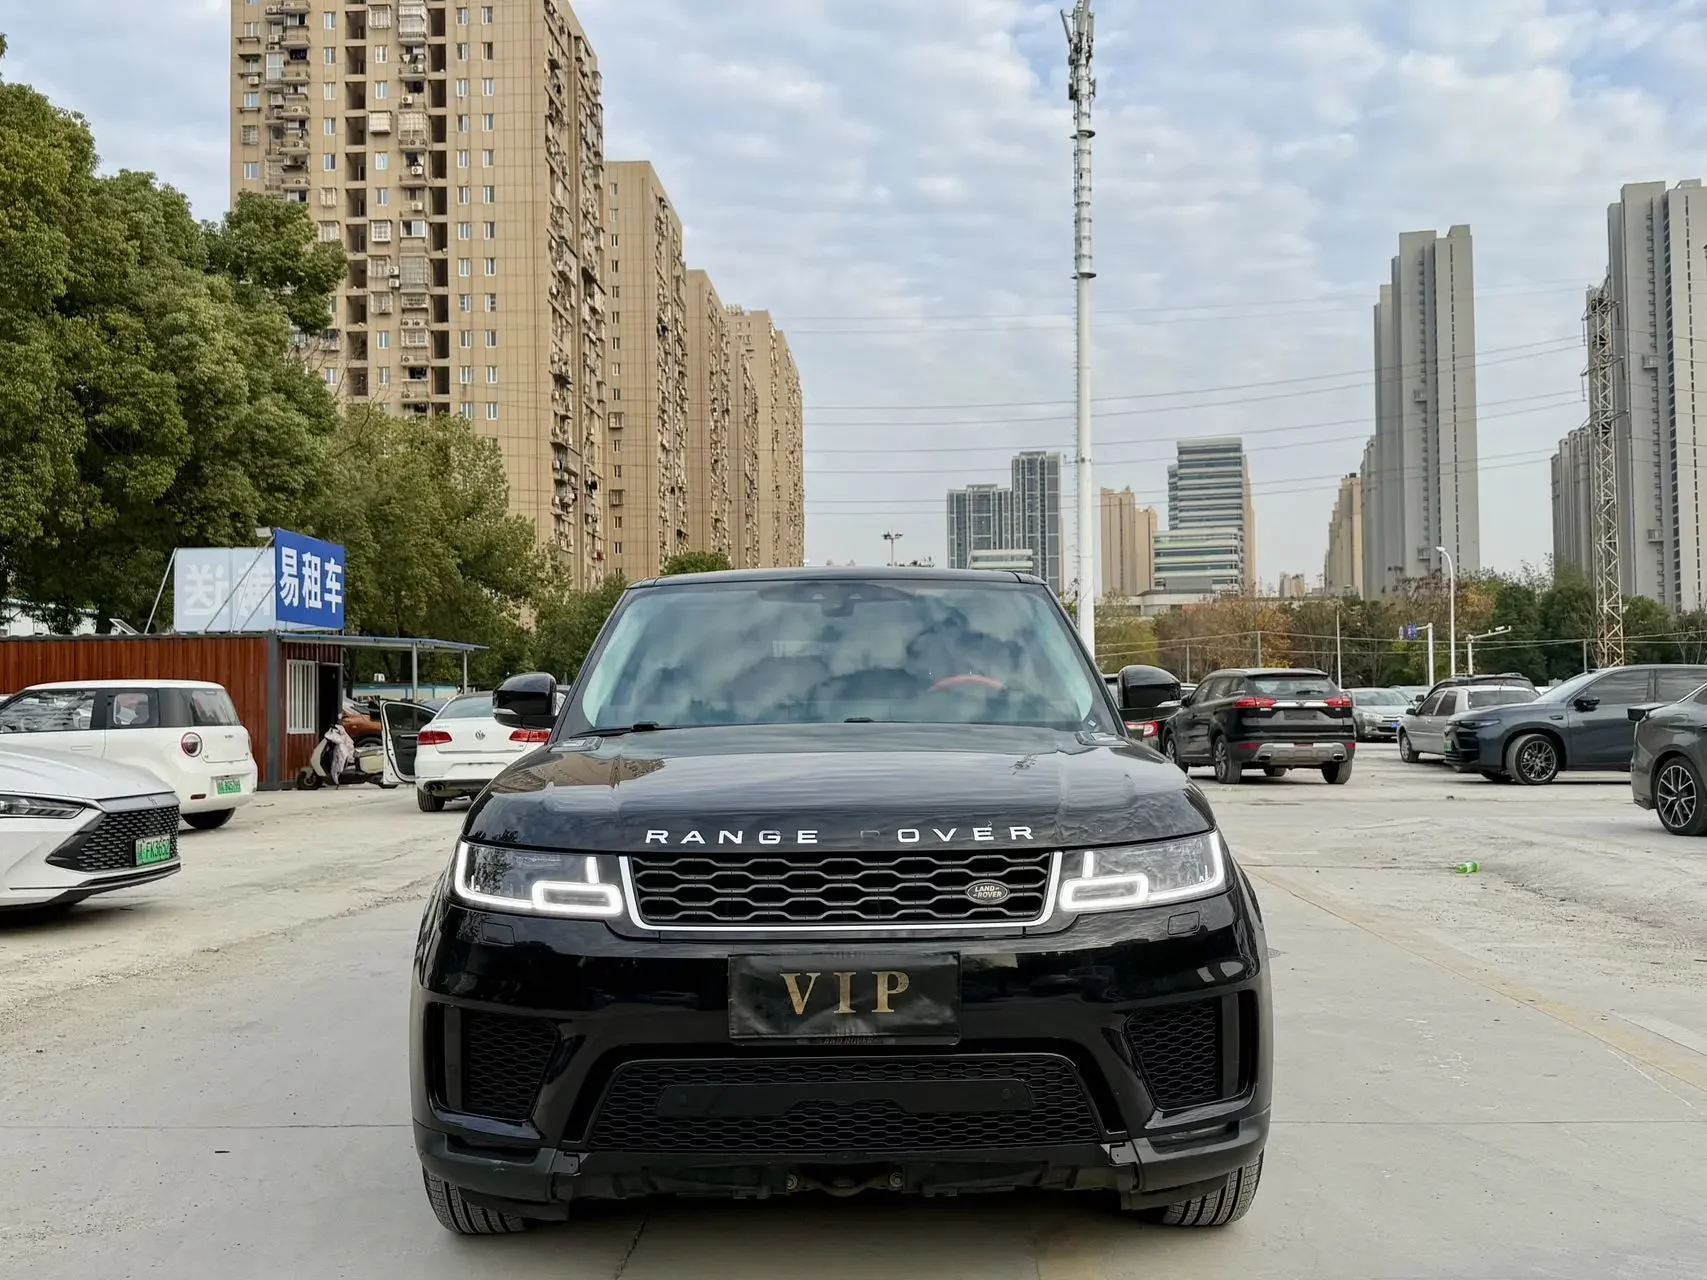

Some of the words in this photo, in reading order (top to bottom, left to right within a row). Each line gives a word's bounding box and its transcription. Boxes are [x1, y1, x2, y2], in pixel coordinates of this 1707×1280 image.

[279, 545, 342, 614] 易租车
[644, 829, 819, 845] RANGE
[780, 970, 910, 1015] VIP
